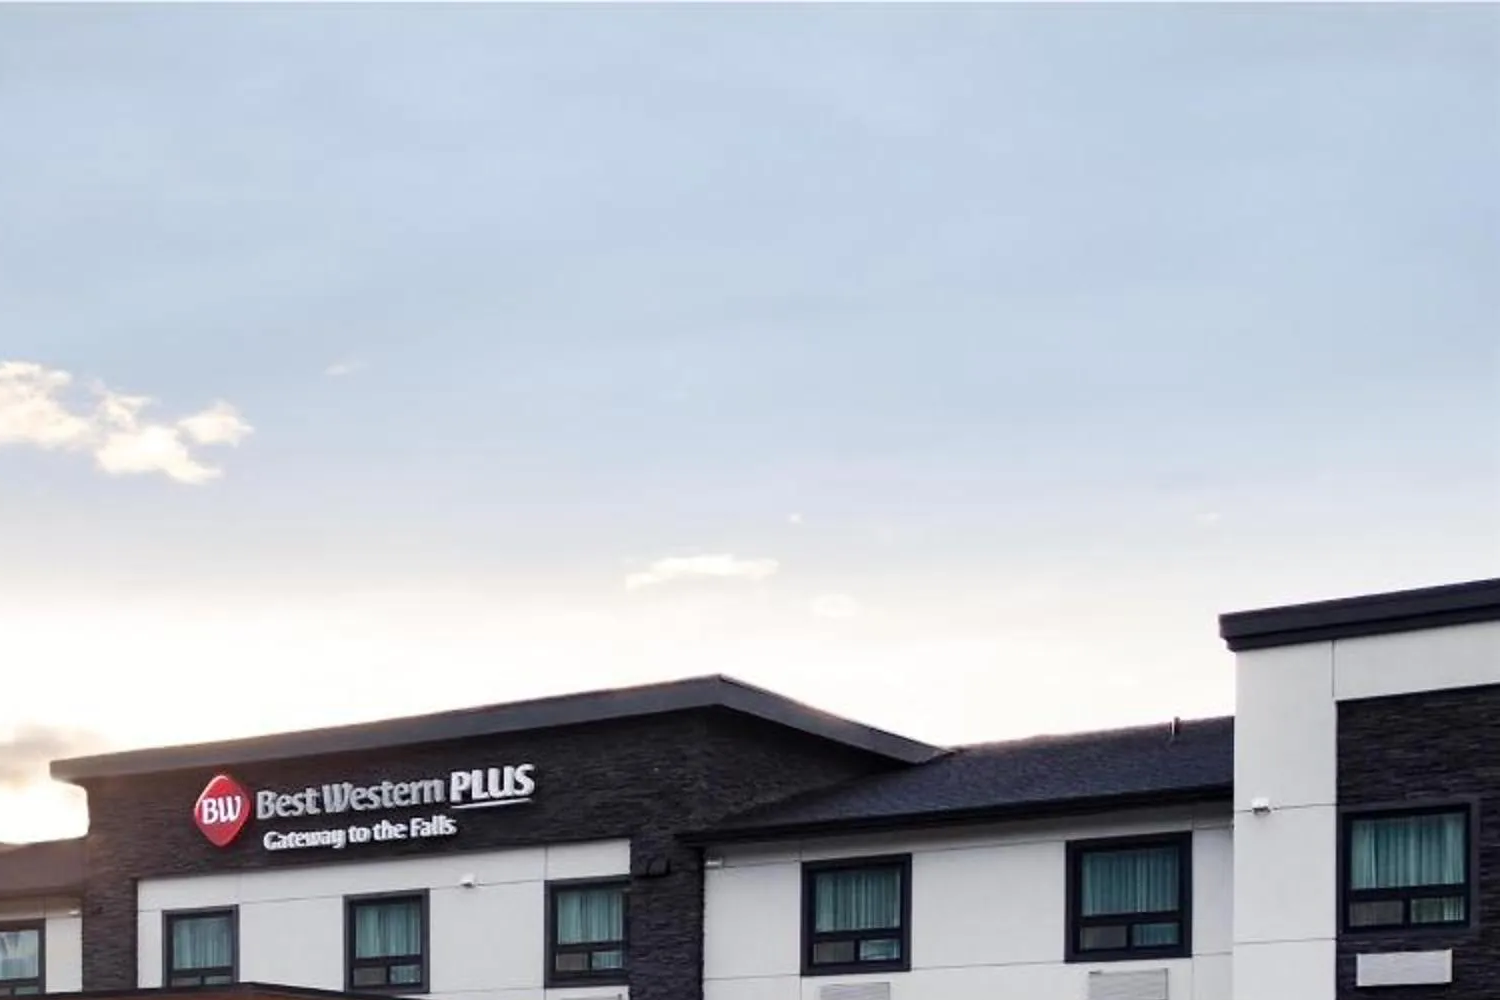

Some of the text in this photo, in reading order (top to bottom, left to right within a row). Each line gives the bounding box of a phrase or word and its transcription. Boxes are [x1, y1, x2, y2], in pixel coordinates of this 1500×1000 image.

[256, 763, 535, 820] Best Western PLUS
[202, 795, 241, 825] BW
[263, 814, 457, 850] Gateway to the Falls
